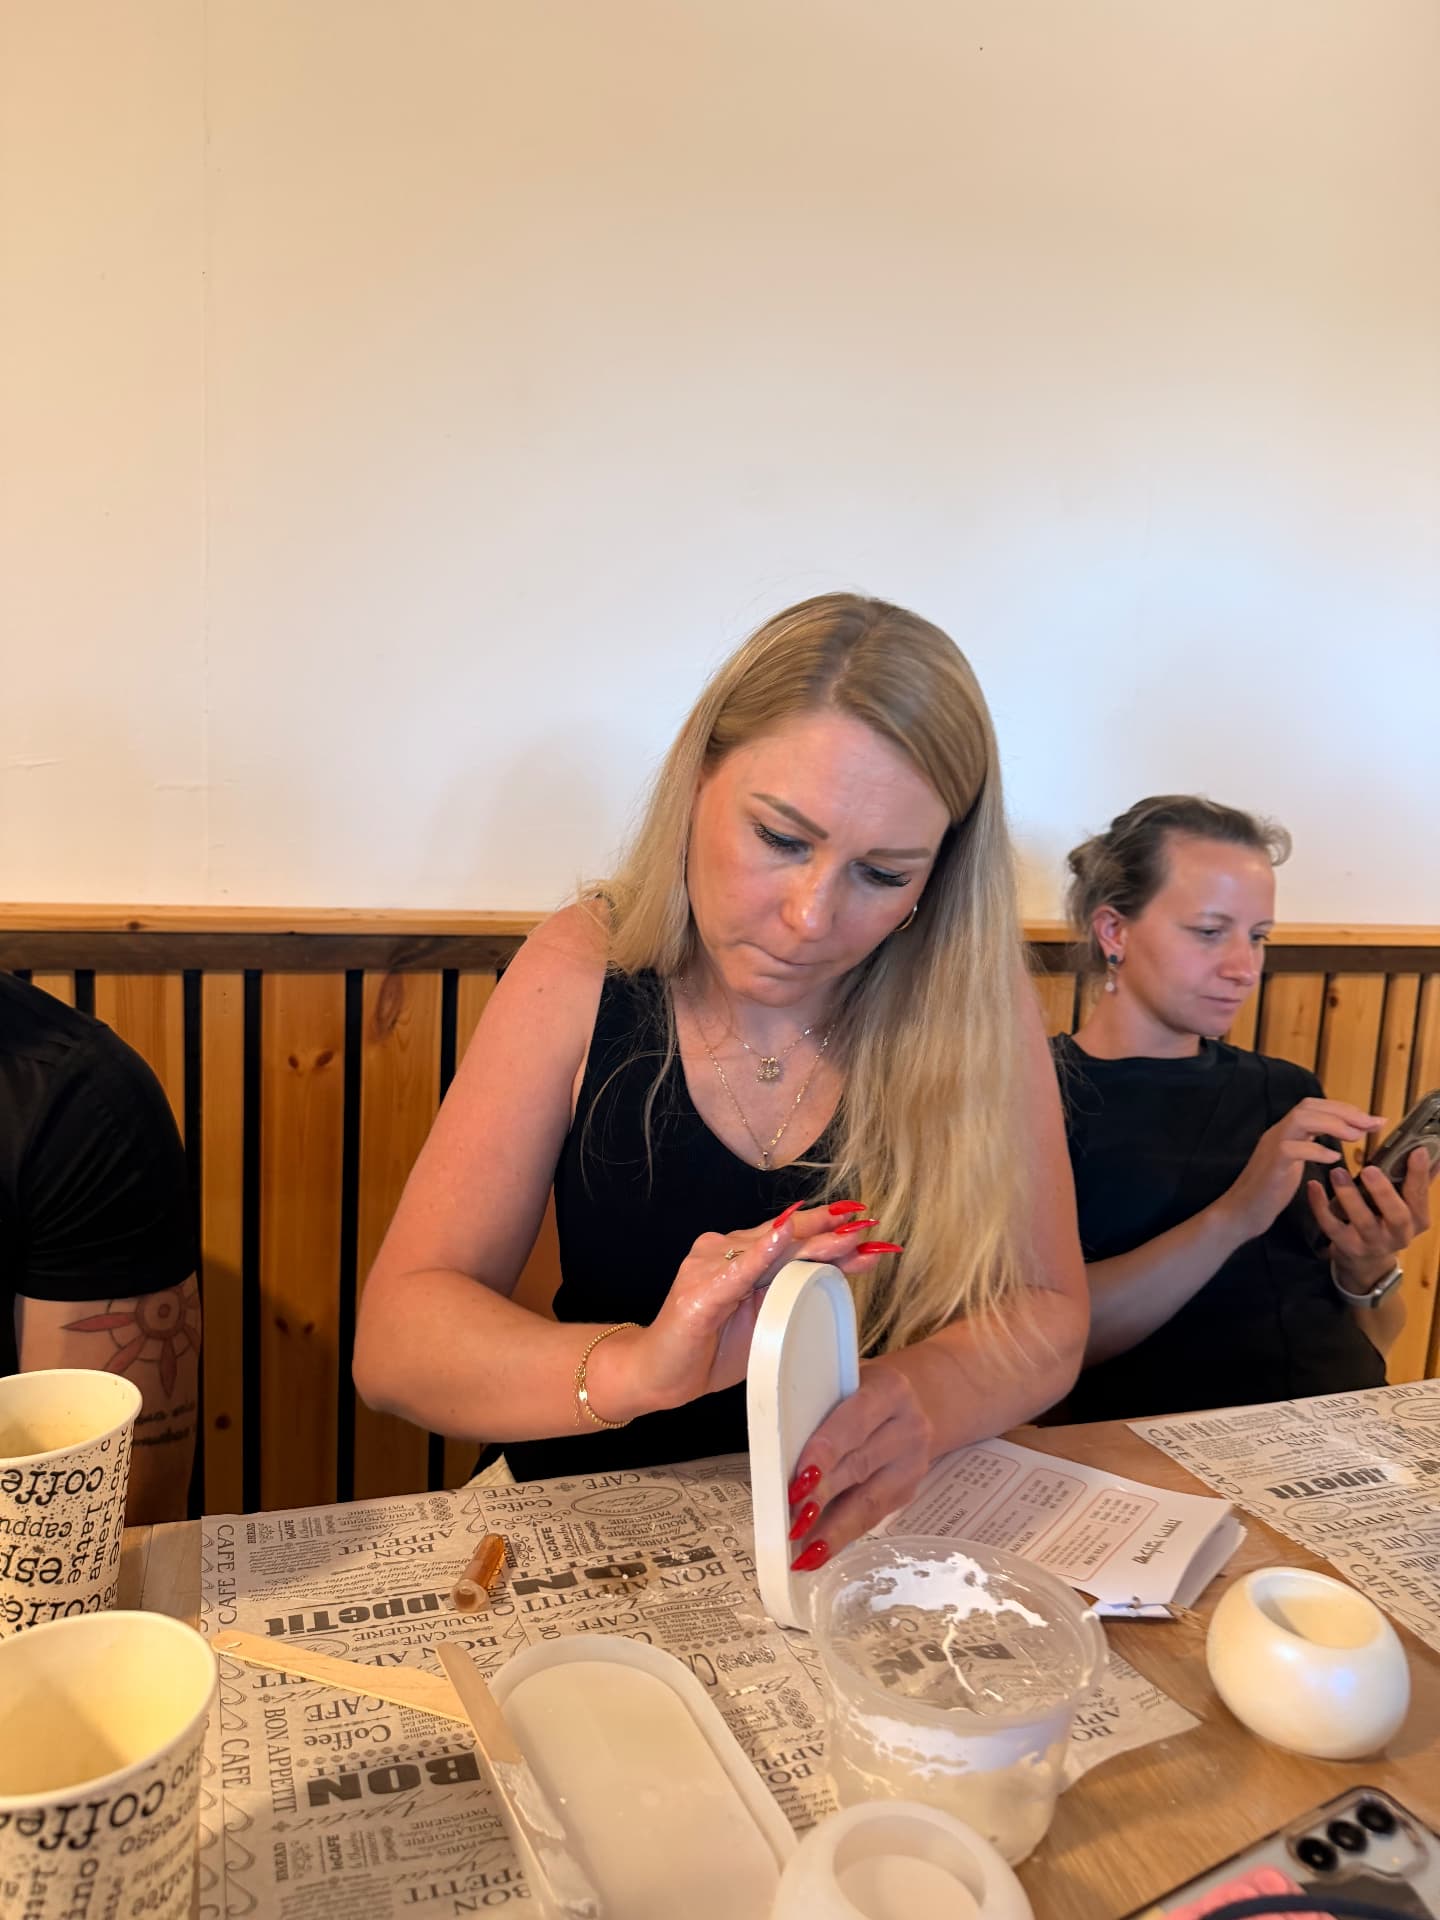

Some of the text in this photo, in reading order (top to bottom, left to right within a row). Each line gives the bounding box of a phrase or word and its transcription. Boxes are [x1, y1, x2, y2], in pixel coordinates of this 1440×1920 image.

[482, 1485, 545, 1499] CAFE
[582, 1473, 640, 1490] CAFE
[484, 1499, 553, 1513] Coffee
[68, 1504, 102, 1584] latte
[217, 1524, 235, 1574] CAFE
[338, 1528, 453, 1556] APPETIT
[373, 1543, 435, 1559] BON
[540, 1526, 563, 1561] leCAFE
[636, 1537, 670, 1547] PARIS
[520, 1560, 727, 1614] BON APPETIT
[218, 1579, 238, 1625] CAFE
[352, 1613, 489, 1641] BOULANGERIE
[400, 1631, 447, 1646] CAFE
[303, 1695, 384, 1723] CAFE
[304, 1724, 392, 1751] Coffee
[221, 1738, 251, 1790] CAFE
[264, 1707, 297, 1814] BON APPETIT
[750, 1743, 825, 1772] APPE
[307, 1751, 481, 1808] BON
[452, 1883, 532, 1916] BON
